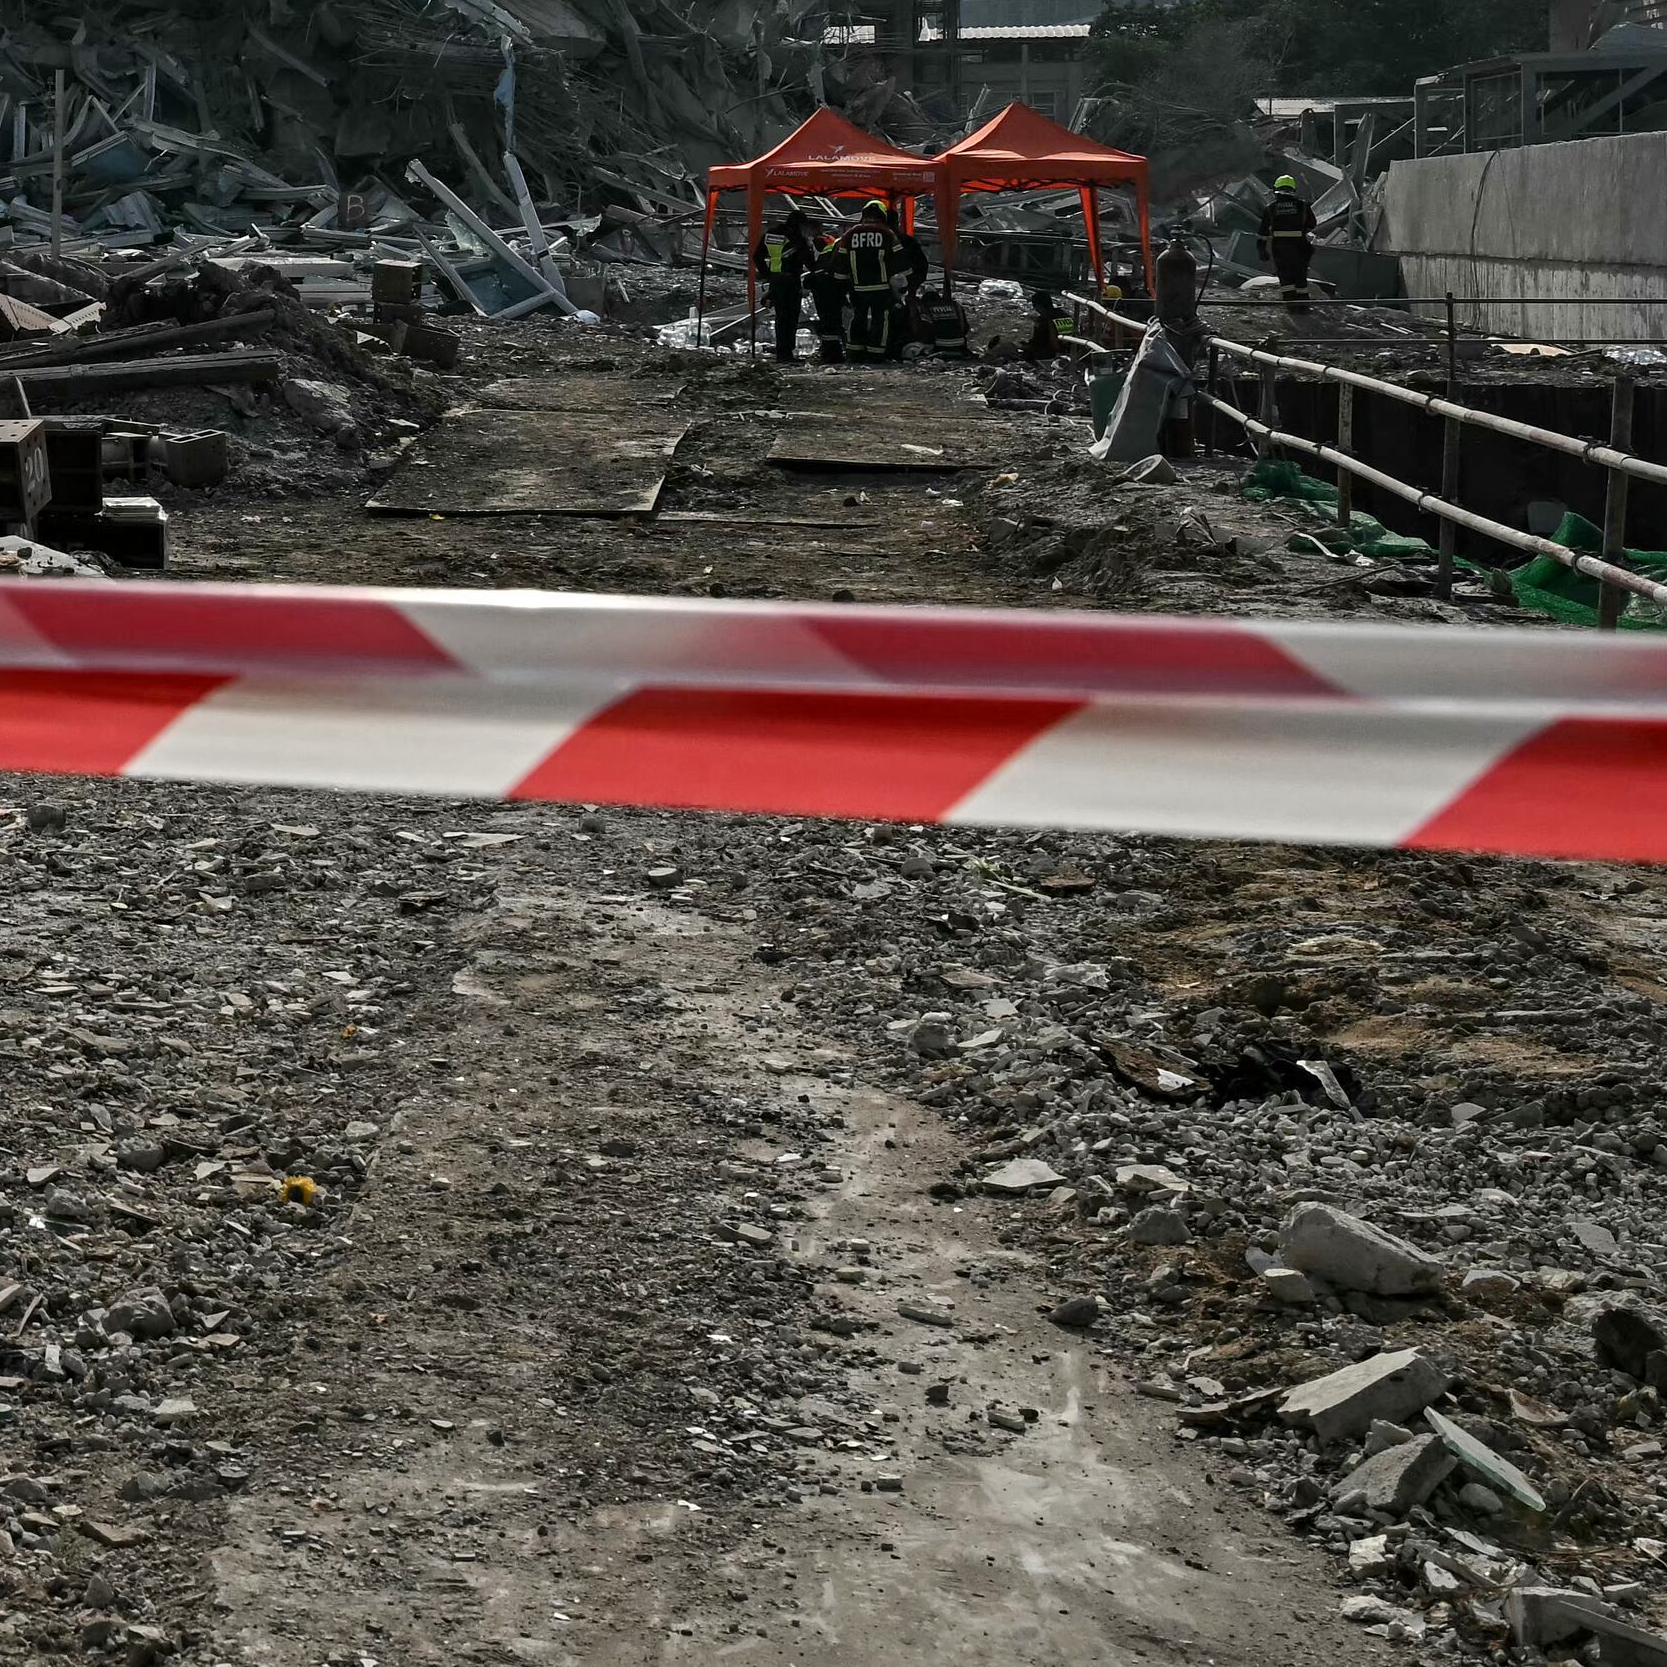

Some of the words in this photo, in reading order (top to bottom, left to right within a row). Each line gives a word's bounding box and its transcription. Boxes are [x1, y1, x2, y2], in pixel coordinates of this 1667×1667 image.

[808, 154, 876, 162] LALAMOVE
[347, 194, 365, 221] B
[851, 232, 884, 249] BFRD
[25, 446, 44, 493] 20
